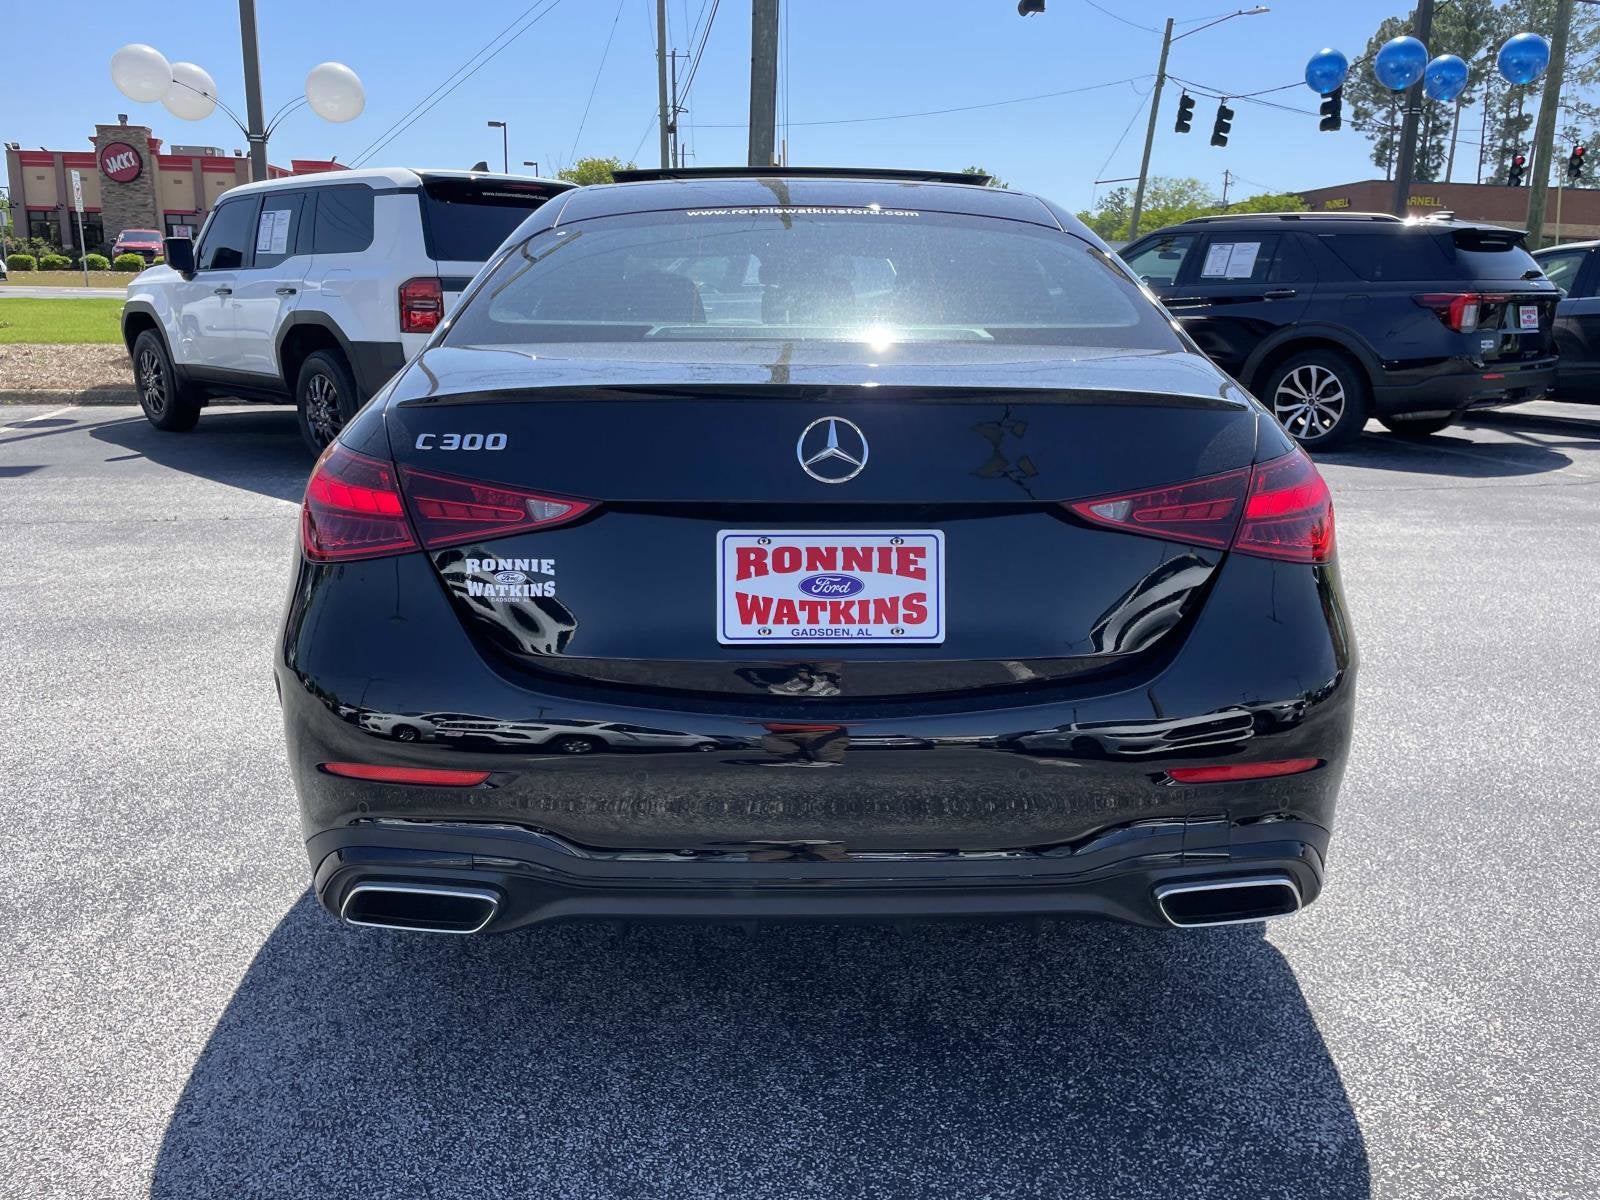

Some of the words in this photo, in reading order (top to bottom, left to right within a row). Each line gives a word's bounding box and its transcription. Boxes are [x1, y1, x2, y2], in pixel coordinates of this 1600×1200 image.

[686, 207, 920, 217] www.ronniewatkinsford.com
[415, 433, 437, 450] C
[439, 433, 508, 451] 300
[465, 558, 555, 575] RONNIE
[735, 546, 927, 581] RONNIE
[465, 579, 556, 597] WATKINS
[735, 591, 928, 625] WATKINS
[791, 628, 853, 637] GADSDEN,
[856, 628, 872, 636] AL
